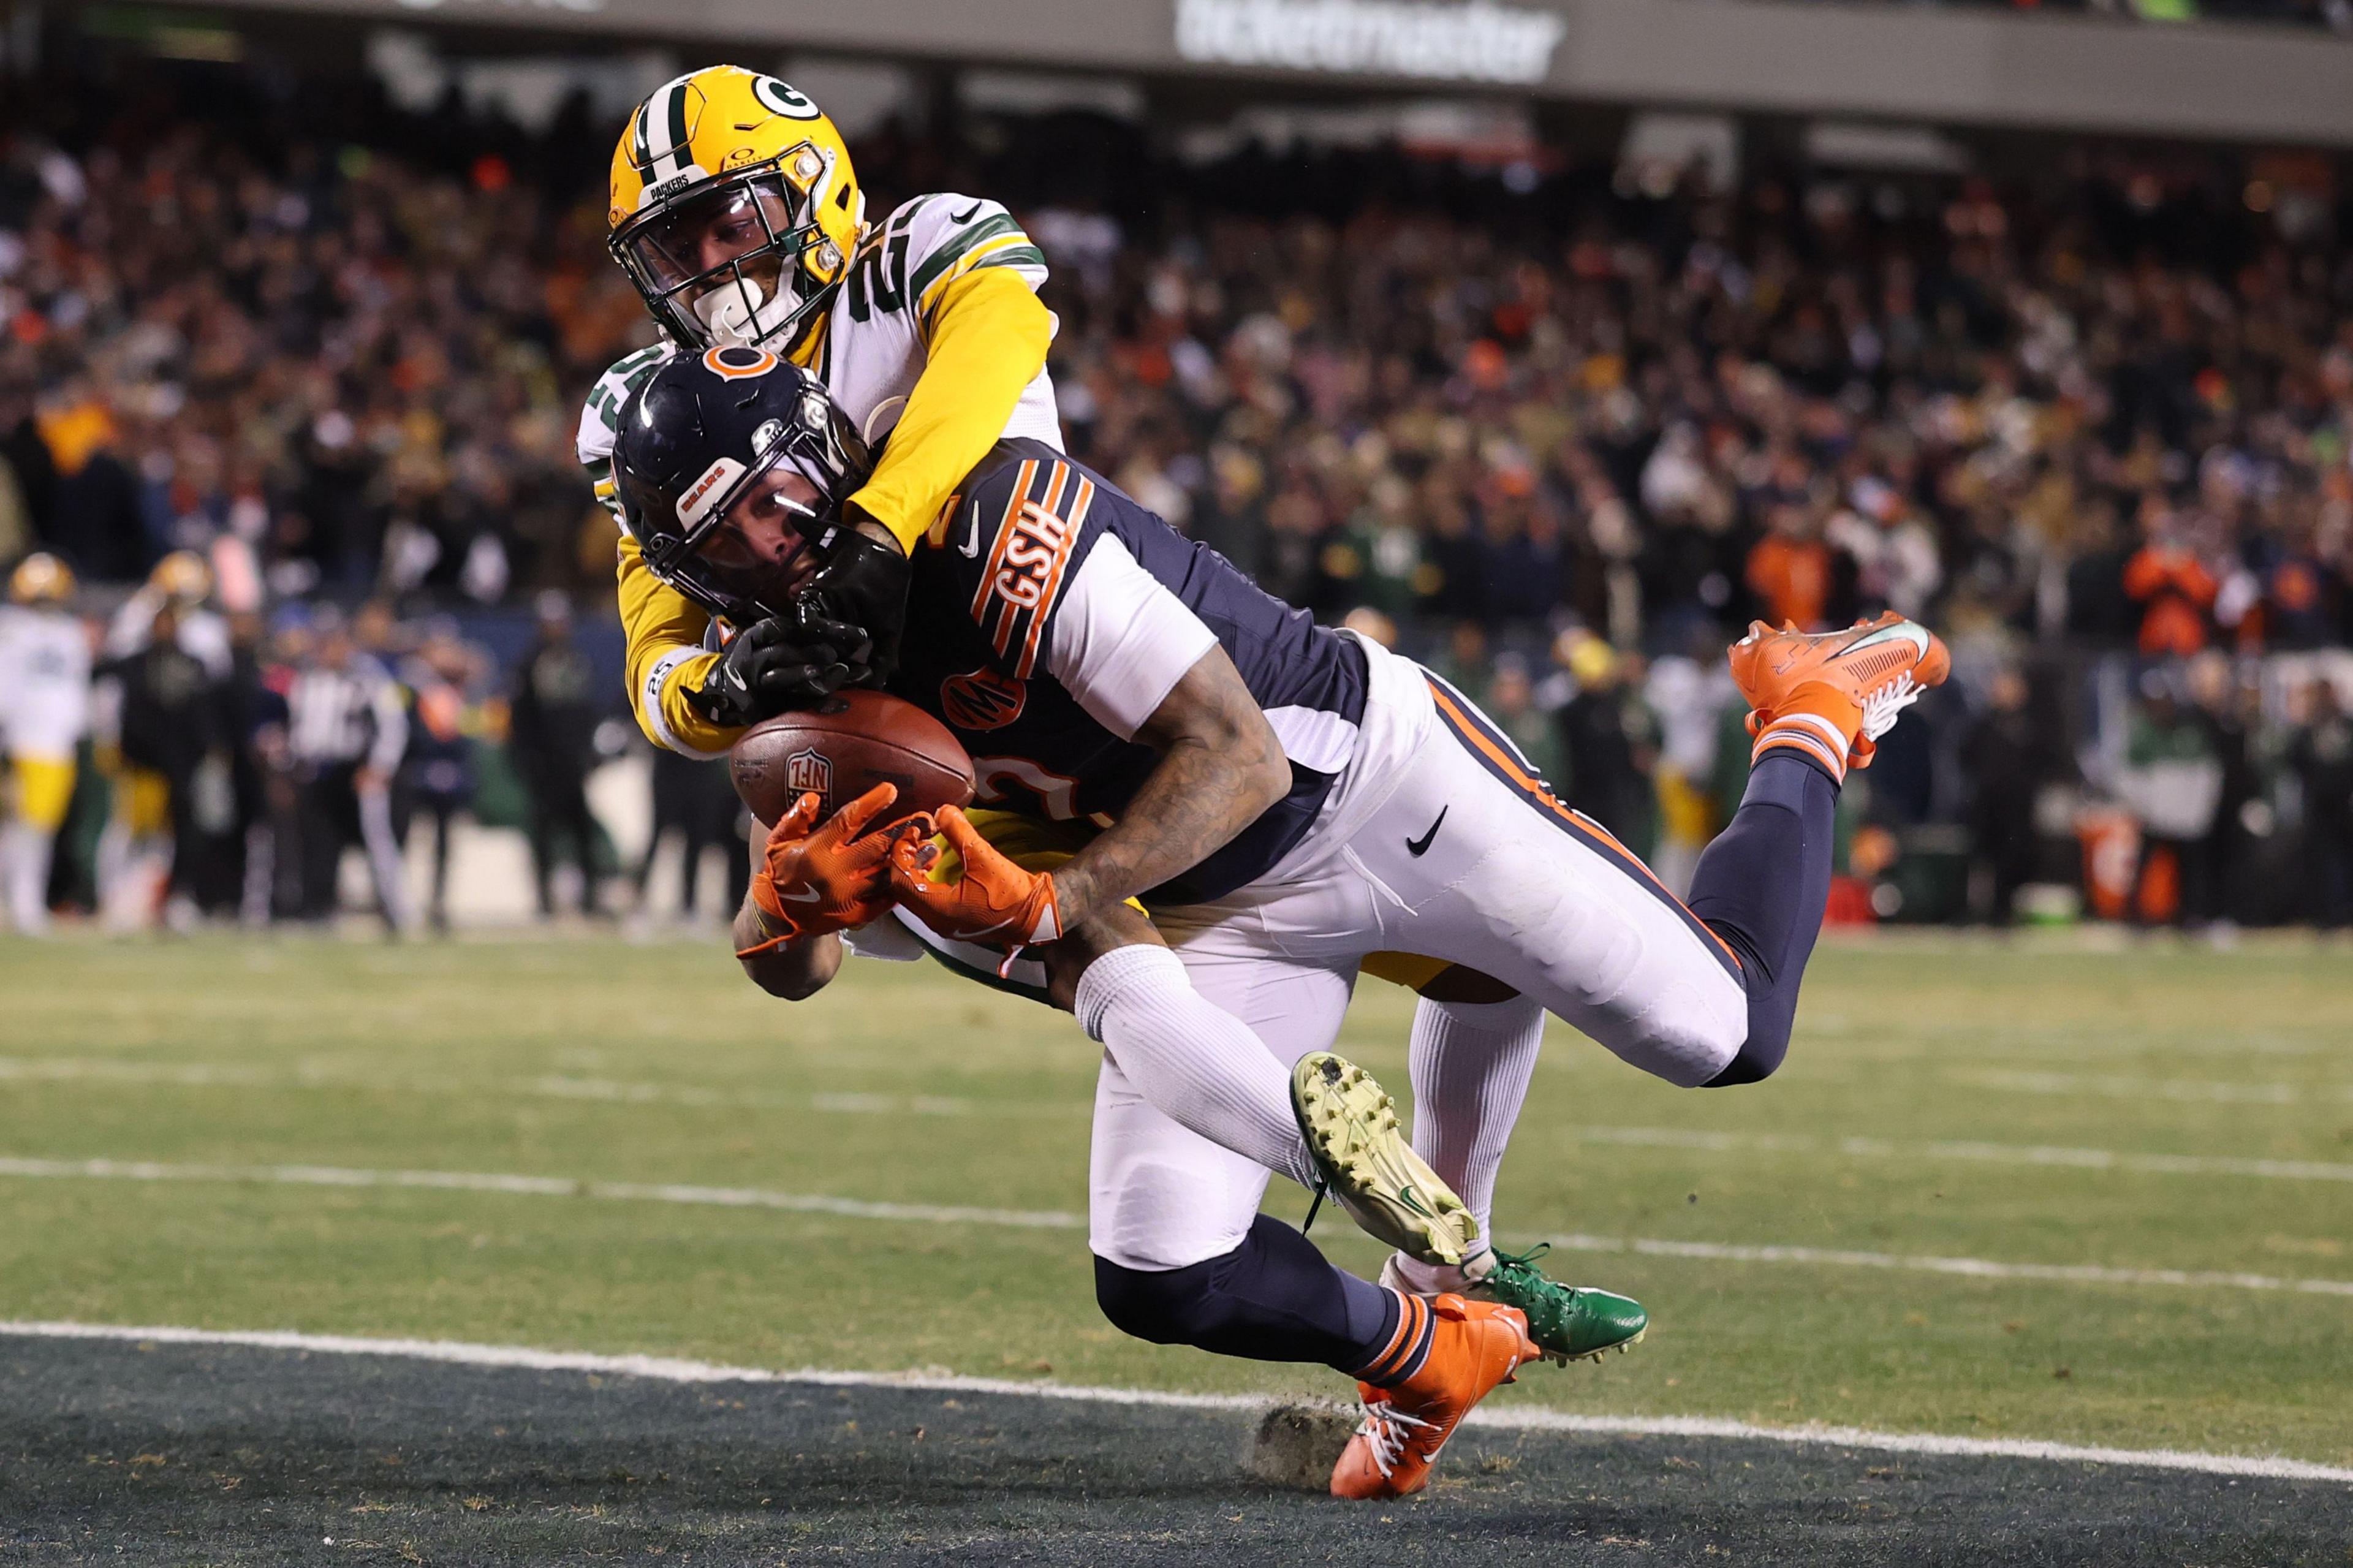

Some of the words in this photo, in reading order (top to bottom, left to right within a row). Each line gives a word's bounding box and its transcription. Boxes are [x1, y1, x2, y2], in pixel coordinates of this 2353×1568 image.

[752, 75, 820, 119] G
[650, 174, 689, 200] PACKERS
[681, 466, 726, 513] BEARS
[994, 499, 1067, 610] GSH
[648, 660, 673, 695] 25
[791, 757, 828, 790] NFL
